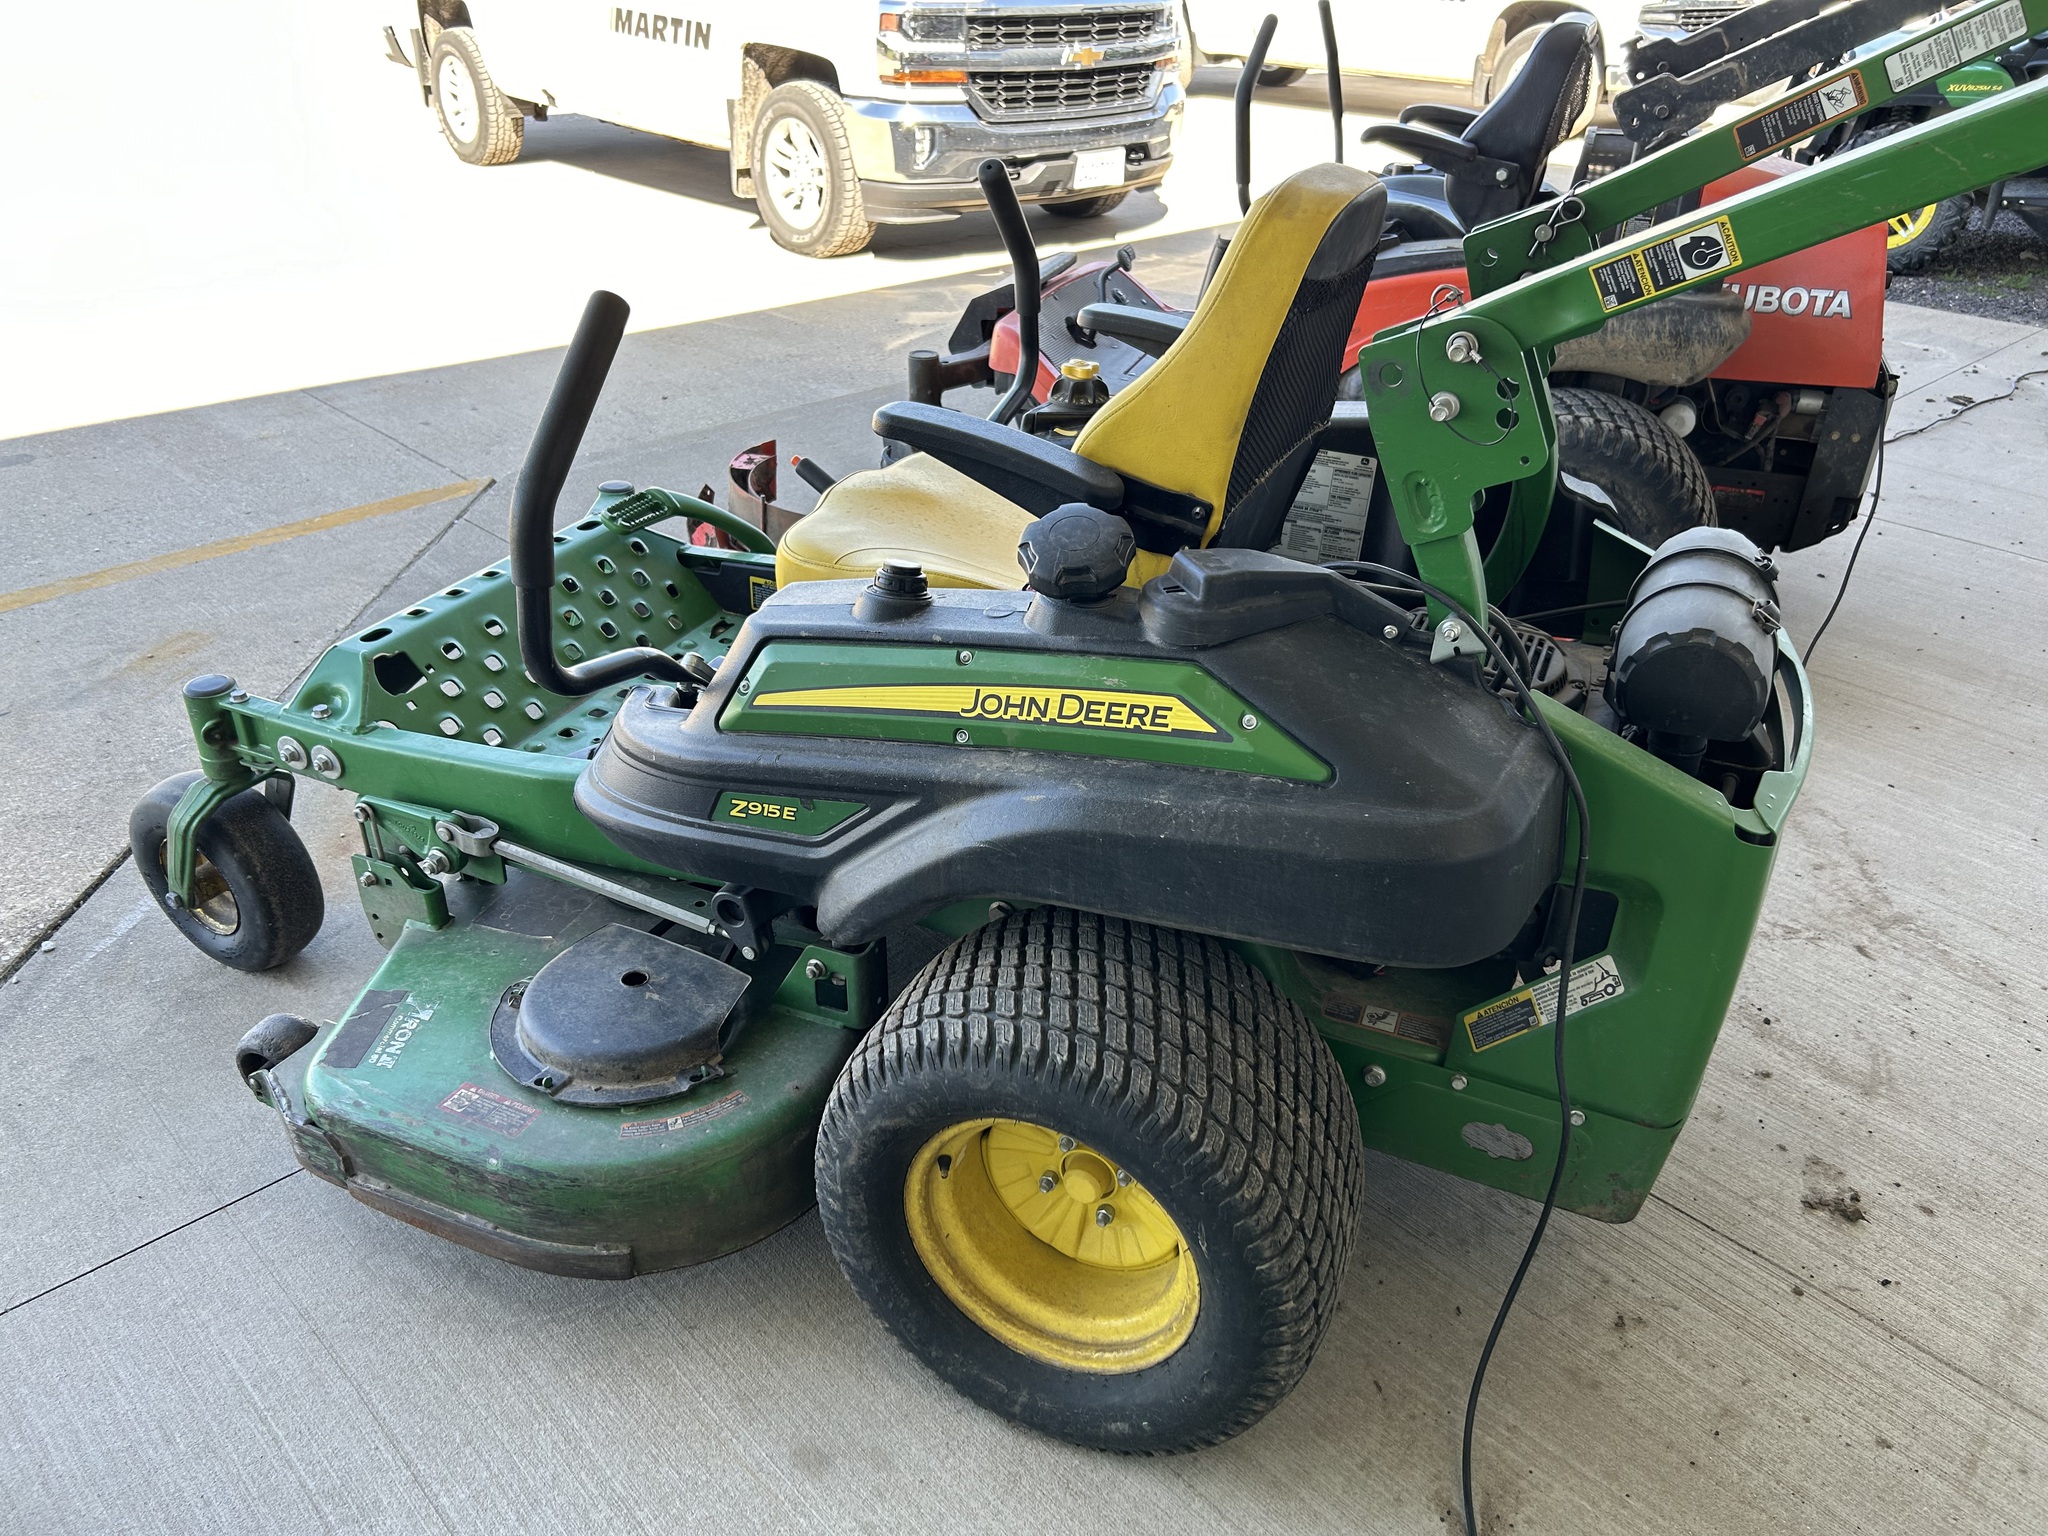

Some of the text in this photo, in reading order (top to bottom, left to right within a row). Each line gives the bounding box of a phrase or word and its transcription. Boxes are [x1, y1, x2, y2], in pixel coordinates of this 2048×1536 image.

[615, 7, 711, 50] MARTIN
[1853, 77, 1867, 105] WARNING
[1722, 227, 1740, 262] CAUTION
[1634, 256, 1652, 296] ATENCIÓN
[1722, 283, 1852, 318] UBOTA
[961, 689, 1173, 729] JOHN DEERE
[729, 799, 798, 821] Z915E
[1484, 996, 1520, 1017] ATENCIÓN
